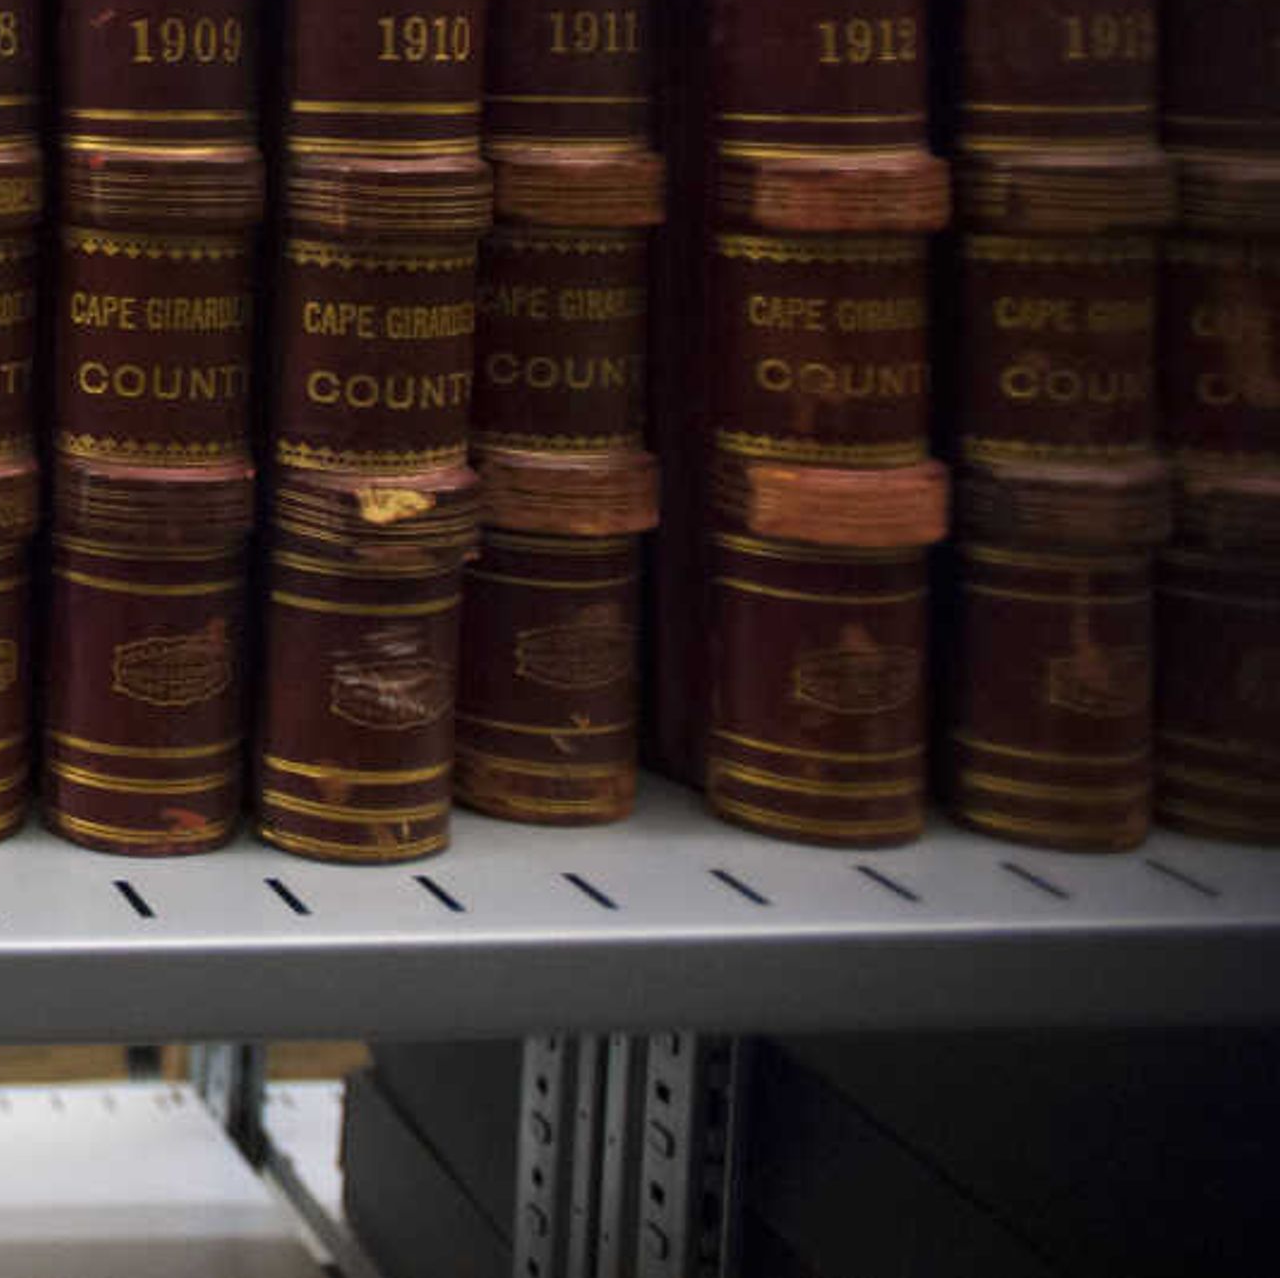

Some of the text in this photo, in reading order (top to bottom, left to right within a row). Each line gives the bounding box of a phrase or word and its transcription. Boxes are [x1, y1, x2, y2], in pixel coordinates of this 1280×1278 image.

[130, 17, 242, 64] 1909
[377, 16, 472, 62] 1910
[70, 290, 138, 331] CAPE
[302, 300, 377, 340] CAPE
